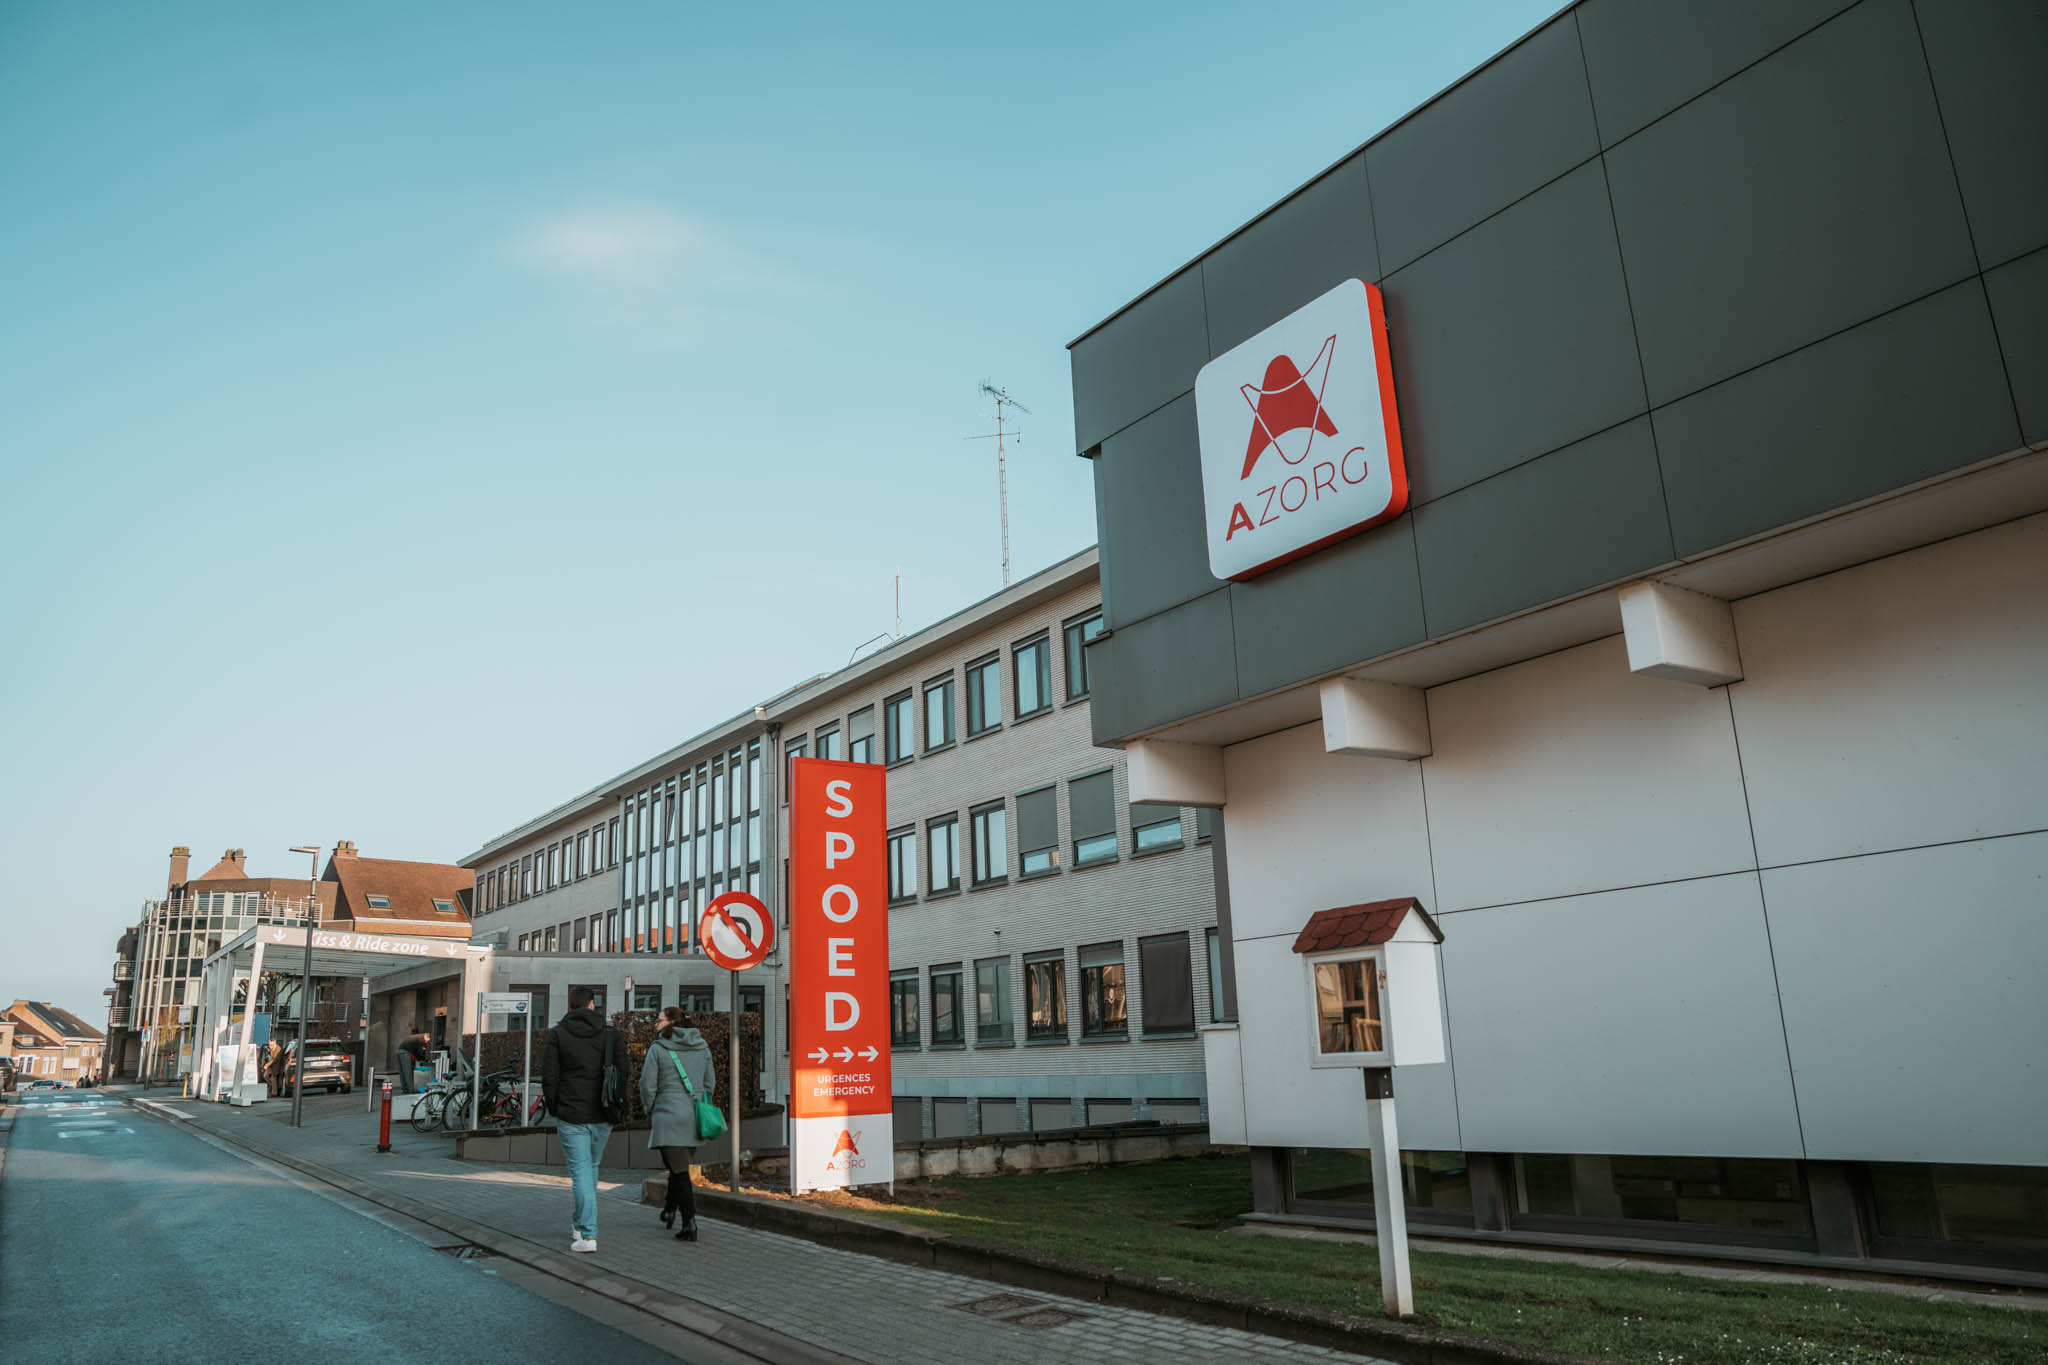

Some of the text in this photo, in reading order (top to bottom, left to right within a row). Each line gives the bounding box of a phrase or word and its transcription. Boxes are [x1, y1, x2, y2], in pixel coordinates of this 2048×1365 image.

[1225, 446, 1369, 542] AZORG
[821, 779, 860, 1032] SPOED
[339, 934, 352, 948] &
[354, 935, 389, 951] Ride
[392, 942, 429, 954] zone
[817, 1073, 871, 1084] URGENCES
[813, 1086, 875, 1097] EMERGENCY
[826, 1158, 866, 1171] AZORG
